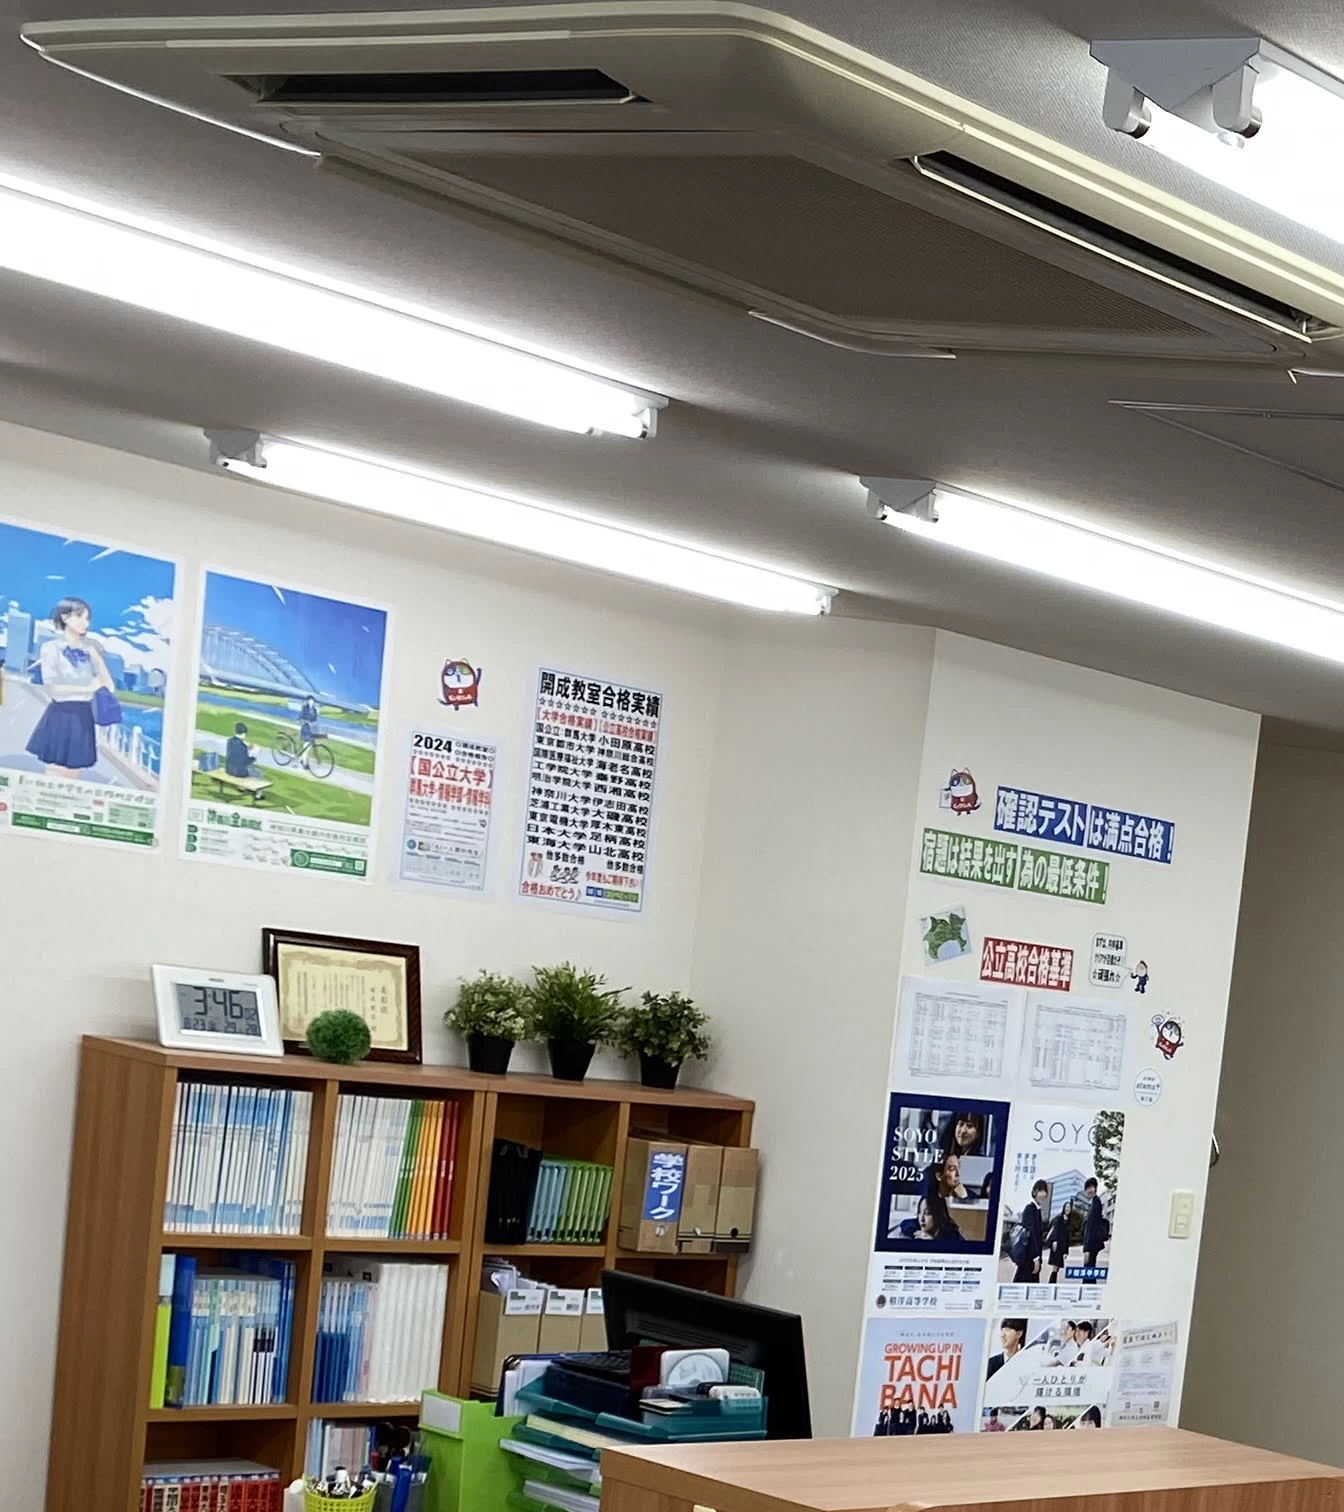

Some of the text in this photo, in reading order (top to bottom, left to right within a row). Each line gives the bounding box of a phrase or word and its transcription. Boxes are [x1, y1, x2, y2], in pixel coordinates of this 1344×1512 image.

[540, 671, 660, 718] 開成教室合格実績
[413, 734, 452, 753] 2024
[893, 1126, 938, 1145] SOYO
[891, 1146, 944, 1165] STYLE
[889, 1165, 925, 1182] 2025
[650, 1152, 685, 1221] 学校ワーク
[884, 1343, 963, 1354] GROWING UP IN
[884, 1355, 962, 1382] TACHI
[879, 1383, 958, 1410] BANA
